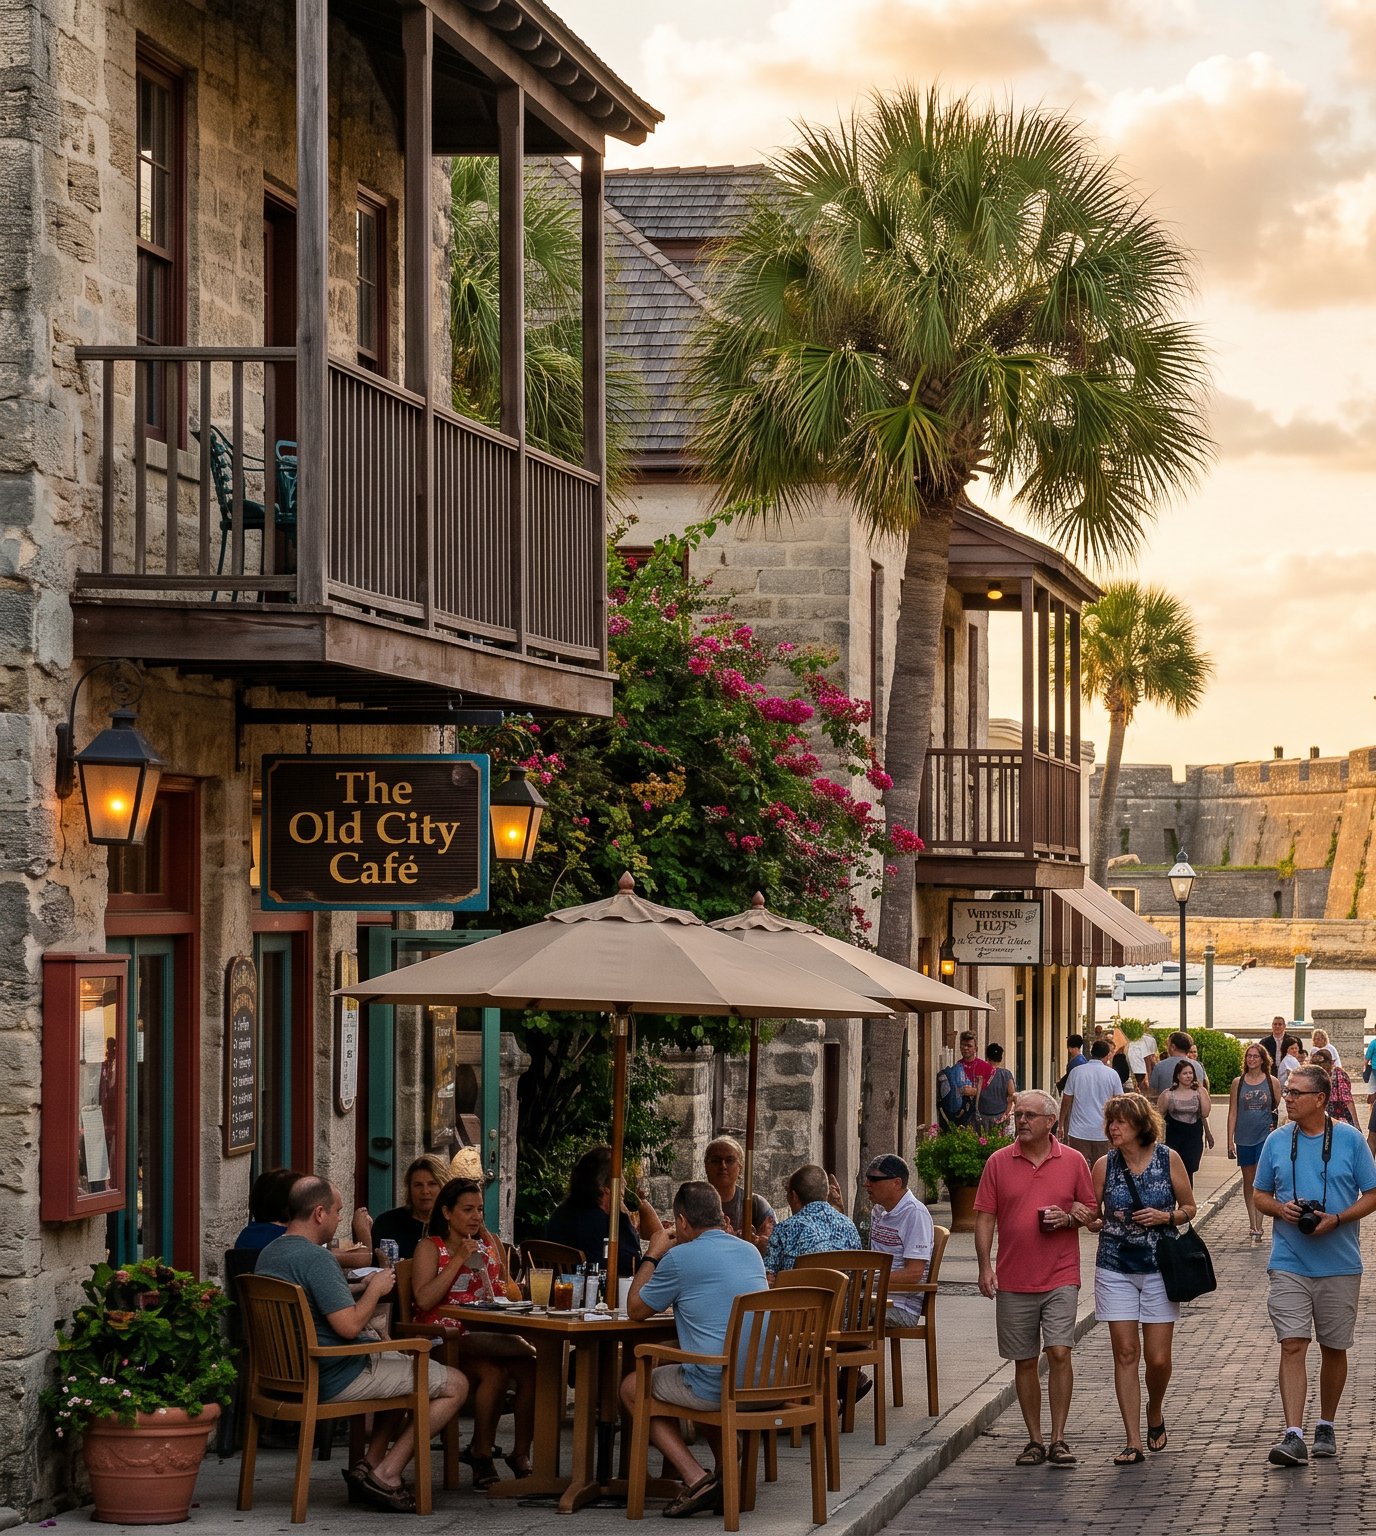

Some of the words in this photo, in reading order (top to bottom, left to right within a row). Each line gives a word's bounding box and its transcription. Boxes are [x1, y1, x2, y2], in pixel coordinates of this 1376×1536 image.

[336, 770, 413, 805] The
[289, 810, 364, 845] Old
[376, 811, 461, 854] City
[329, 851, 419, 886] Café
